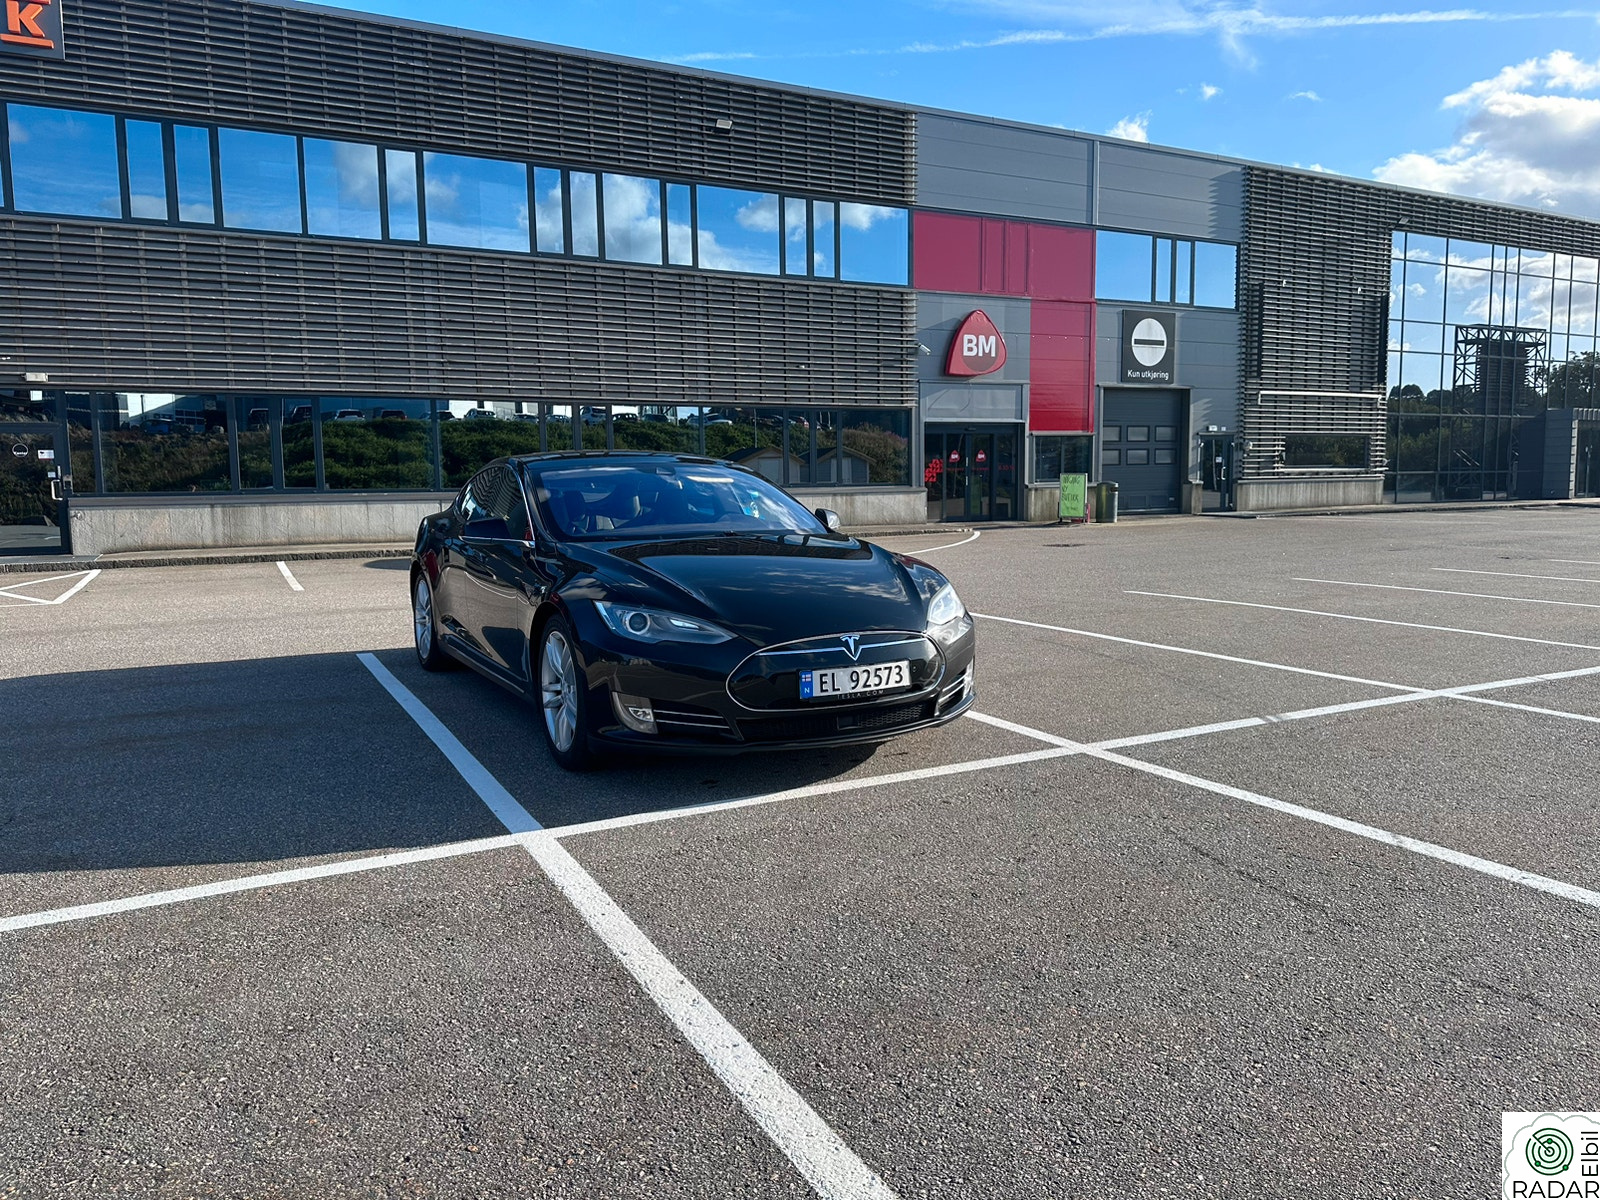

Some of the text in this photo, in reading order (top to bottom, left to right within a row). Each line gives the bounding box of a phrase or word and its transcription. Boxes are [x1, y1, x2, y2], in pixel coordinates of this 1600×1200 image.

[962, 334, 996, 357] BM
[1127, 369, 1169, 381] Kun utkjøring
[819, 665, 903, 693] EL 92573
